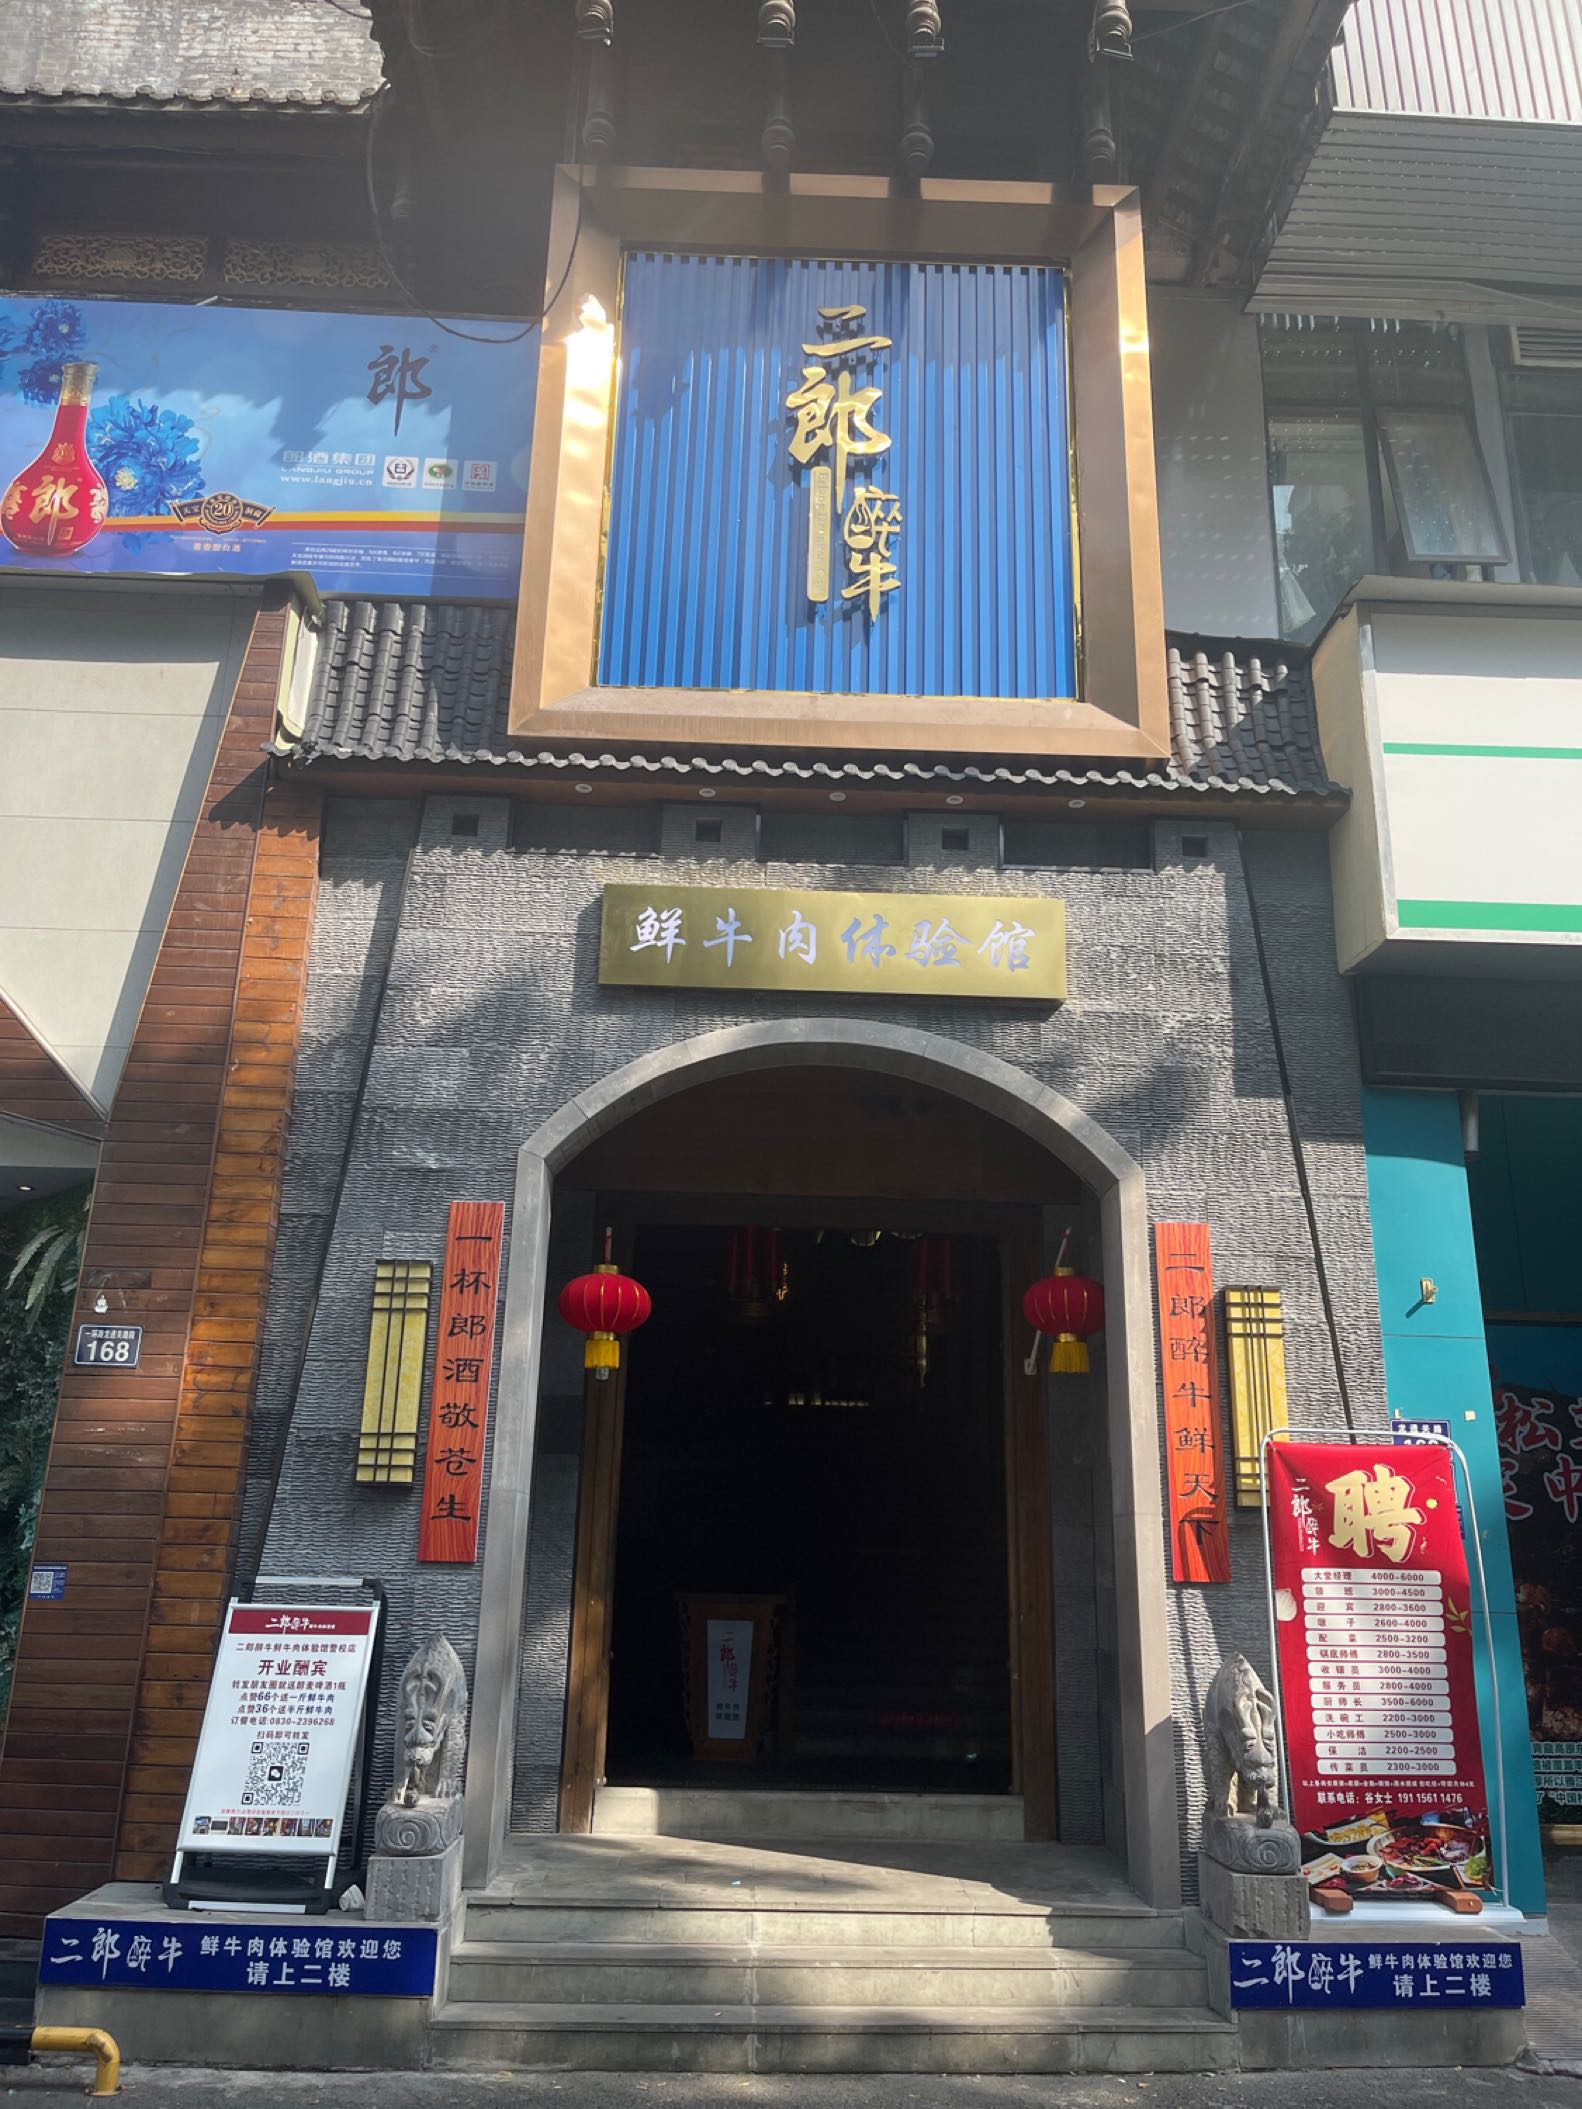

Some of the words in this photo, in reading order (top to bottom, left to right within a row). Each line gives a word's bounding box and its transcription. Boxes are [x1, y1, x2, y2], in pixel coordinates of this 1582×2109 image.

[366, 345, 434, 437] 郎
[283, 450, 376, 466] 郎酒集团
[281, 466, 331, 475] LANGJIU
[336, 468, 375, 477] GROUP
[281, 475, 373, 487] www.langjiu.cn
[29, 475, 79, 545] 郎
[214, 502, 233, 517] 20
[630, 906, 1037, 973] 鲜牛肉体验馆
[87, 1341, 130, 1362] 168
[430, 1235, 493, 1521] 一杯郎酒敬苍生
[1165, 1252, 1221, 1545] 二郎醉牛鲜天下
[1325, 1464, 1425, 1563] 聘
[1314, 1571, 1352, 1581] 大堂经理
[1371, 1572, 1424, 1581] 4000-6000
[1372, 1588, 1425, 1597] 3000-4500
[1373, 1603, 1427, 1612] 2800-3600
[1374, 1619, 1427, 1627] 2600-4000
[1376, 1634, 1428, 1643] 2500-3200
[1377, 1650, 1430, 1659] 2800-3500
[258, 1659, 328, 1676] 开业酬宾
[1378, 1666, 1431, 1675] 3000-4000
[1379, 1681, 1432, 1690] 2800-4000
[1381, 1697, 1434, 1706] 3500-6000
[1382, 1714, 1435, 1723] 2200-3000
[256, 1731, 310, 1740] 扫码即可转发
[1327, 1729, 1365, 1739] 小吃师傅
[1384, 1730, 1437, 1739] 2500-3000
[1385, 1746, 1438, 1755] 2200-2500
[1387, 1763, 1440, 1771] 2300-3000
[1398, 1793, 1414, 1804] 191
[1416, 1793, 1438, 1804] 1561
[1440, 1793, 1463, 1804] 1476
[200, 1934, 403, 1960] 鲜牛肉体验馆欢迎您
[1367, 1953, 1513, 1969] 鲜牛肉体验馆欢迎您
[246, 1961, 351, 1988] 请上二楼
[1393, 1974, 1492, 1997] 请上二楼
